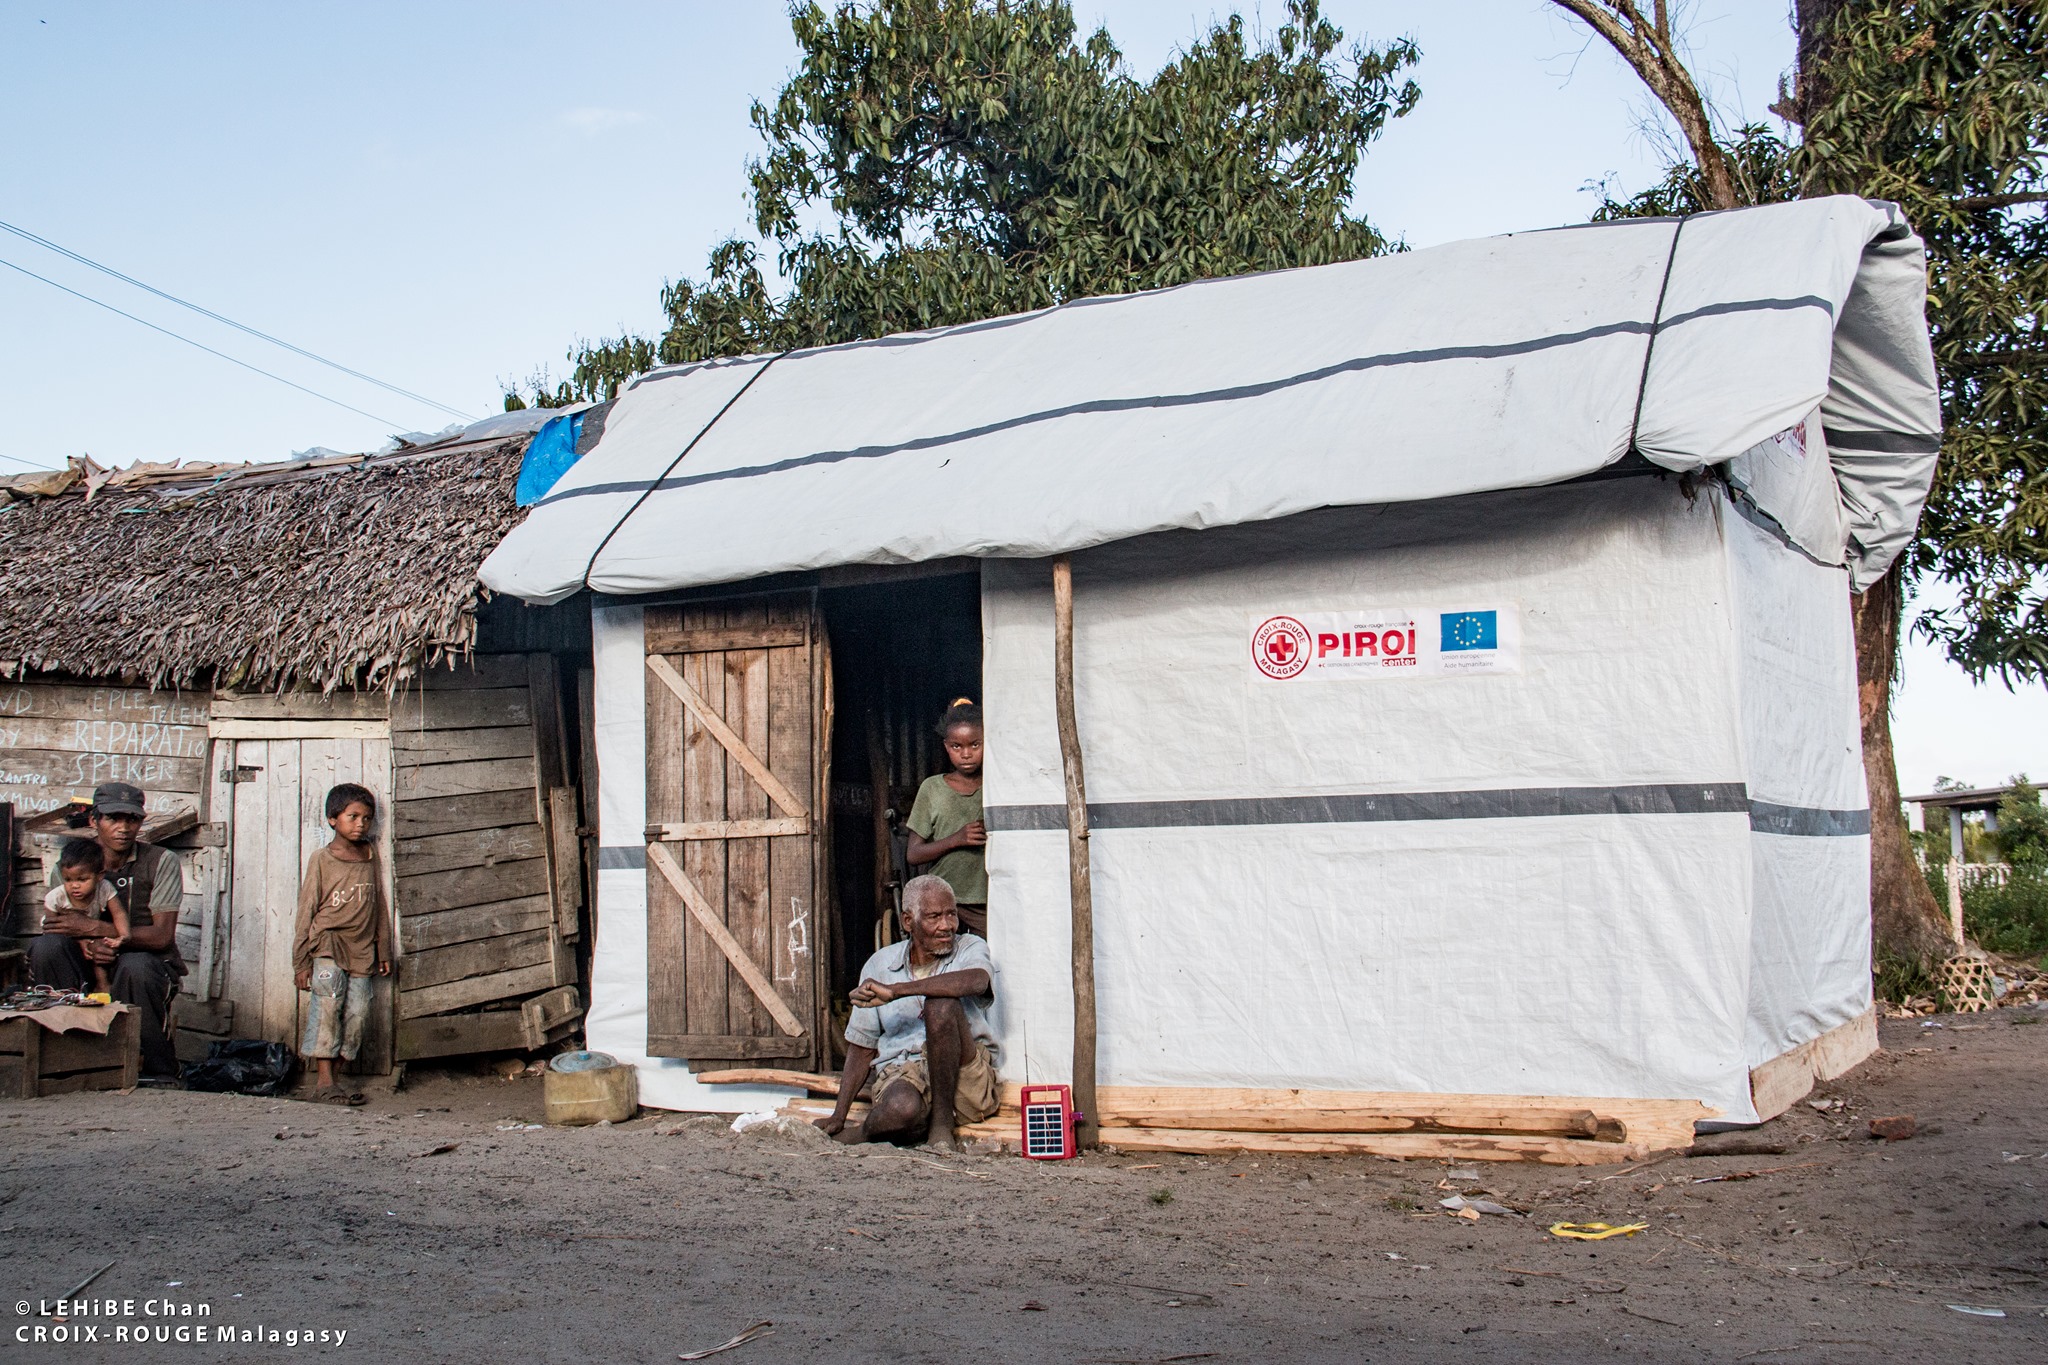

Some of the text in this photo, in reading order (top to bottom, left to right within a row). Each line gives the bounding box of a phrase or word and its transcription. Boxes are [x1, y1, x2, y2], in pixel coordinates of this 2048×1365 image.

[1257, 621, 1306, 646] CROIX-ROUGE
[1260, 657, 1303, 675] MALAGASY
[1382, 658, 1416, 667] center
[1458, 660, 1493, 668] humanitaire
